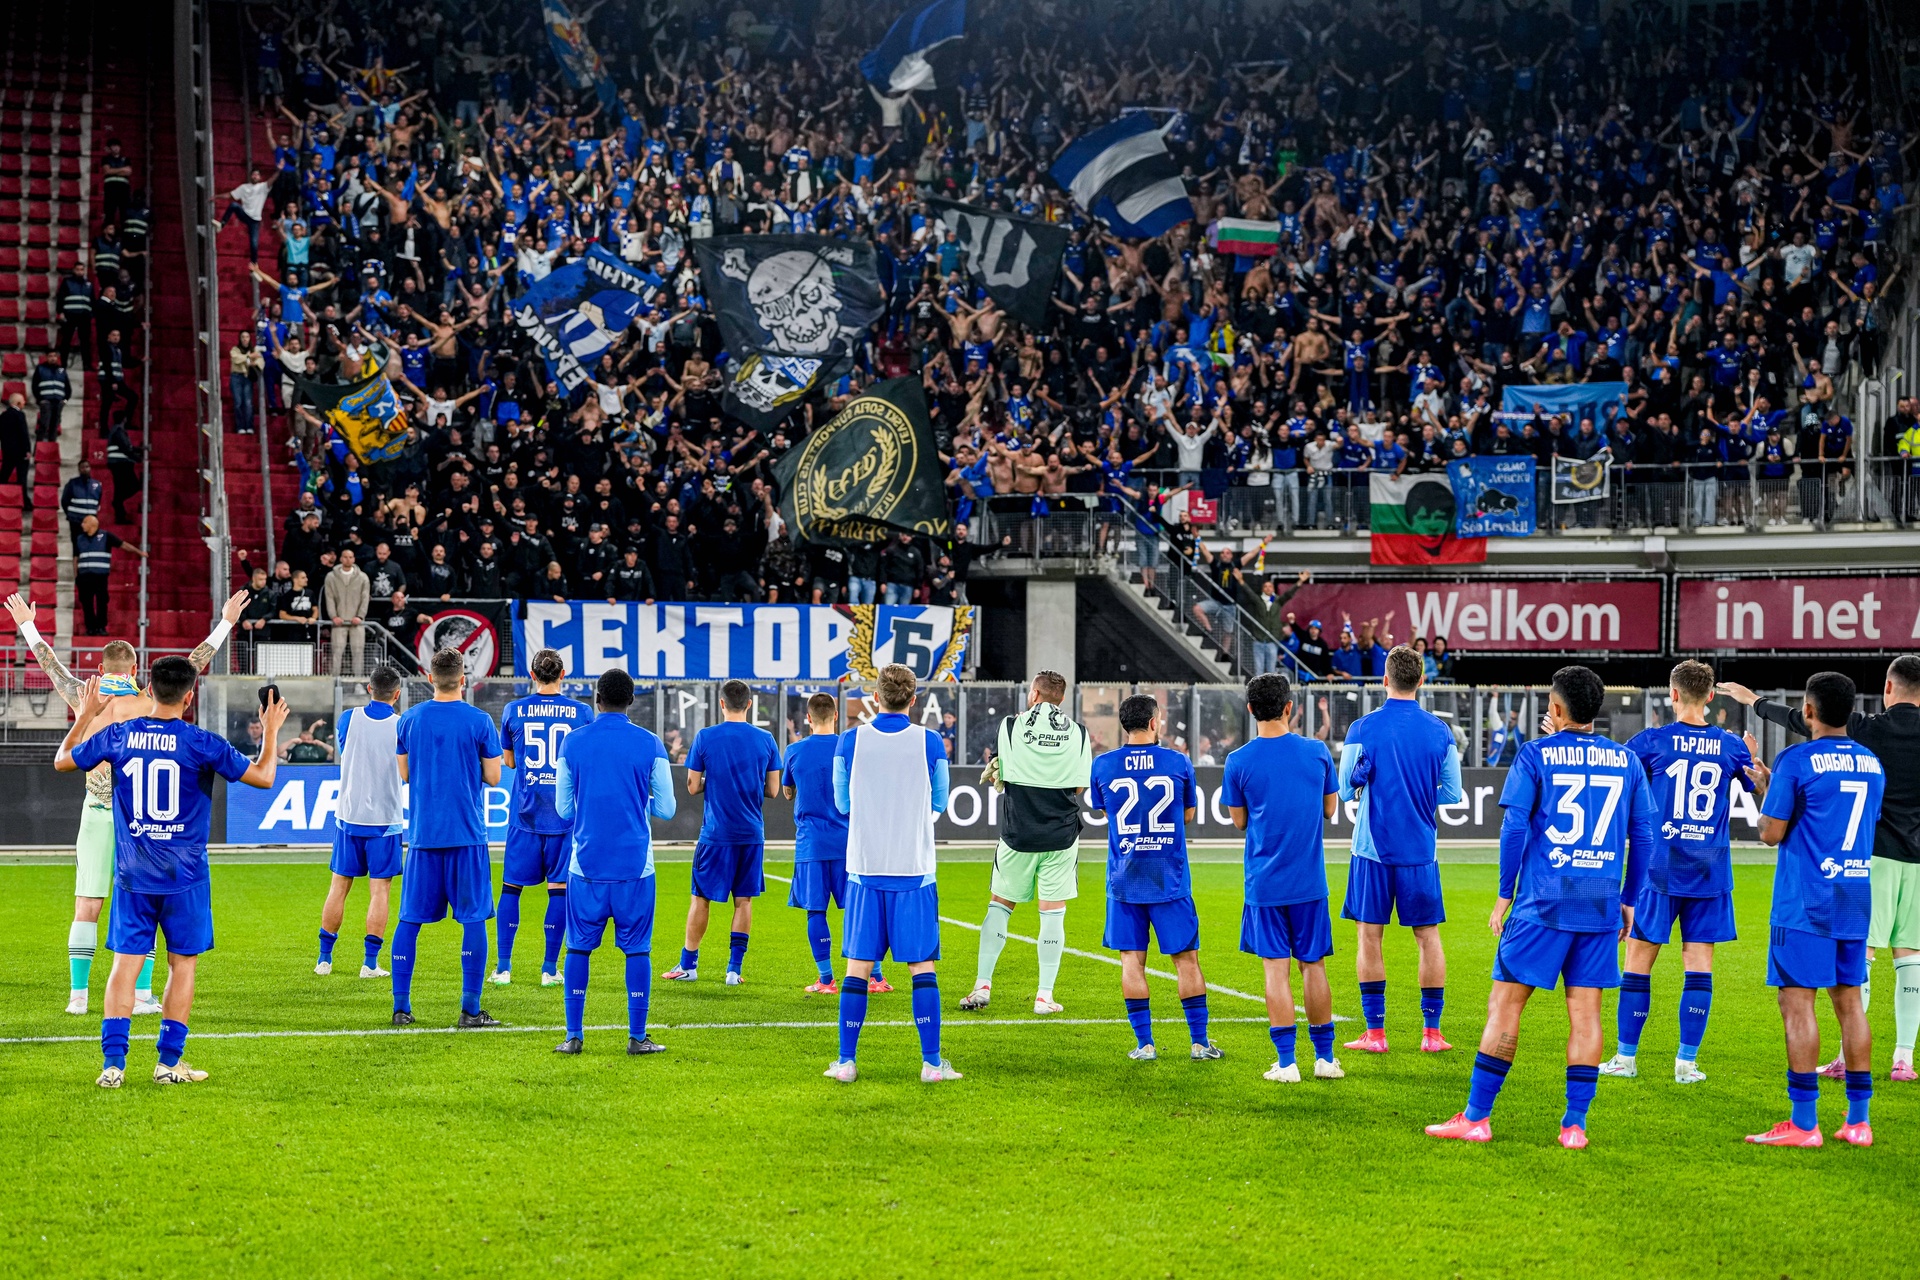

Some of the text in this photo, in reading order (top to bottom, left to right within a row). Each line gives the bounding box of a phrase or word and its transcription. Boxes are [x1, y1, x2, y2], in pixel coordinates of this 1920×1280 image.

[1406, 589, 1620, 642] Welkom
[1716, 586, 1764, 641] in
[1793, 585, 1882, 641] het
[524, 602, 855, 680] СЕКТОР
[517, 705, 577, 719] К. ДИМИТРОВ
[127, 731, 178, 752] МИТКОВ
[524, 722, 572, 769] 50
[1038, 733, 1070, 742] PALMS
[1672, 735, 1722, 757] ТЪРДИН
[1125, 755, 1154, 771] СУЛА
[1541, 745, 1629, 768] РИЛДО ФИЛЬО
[1810, 753, 1855, 774] ФАБИО
[539, 772, 557, 780] PAL
[122, 756, 181, 821] 10
[1665, 758, 1723, 821] 18
[1108, 775, 1175, 835] 22
[1544, 773, 1624, 847] 37
[1840, 780, 1868, 851] 7
[142, 823, 185, 833] PALMS
[1681, 823, 1714, 834] PALMS
[1135, 836, 1174, 845] PALMS
[1572, 849, 1616, 861] PALMS
[1903, 986, 1919, 994] 1914
[917, 1016, 931, 1024] 1914
[1689, 1006, 1706, 1015] 1914
